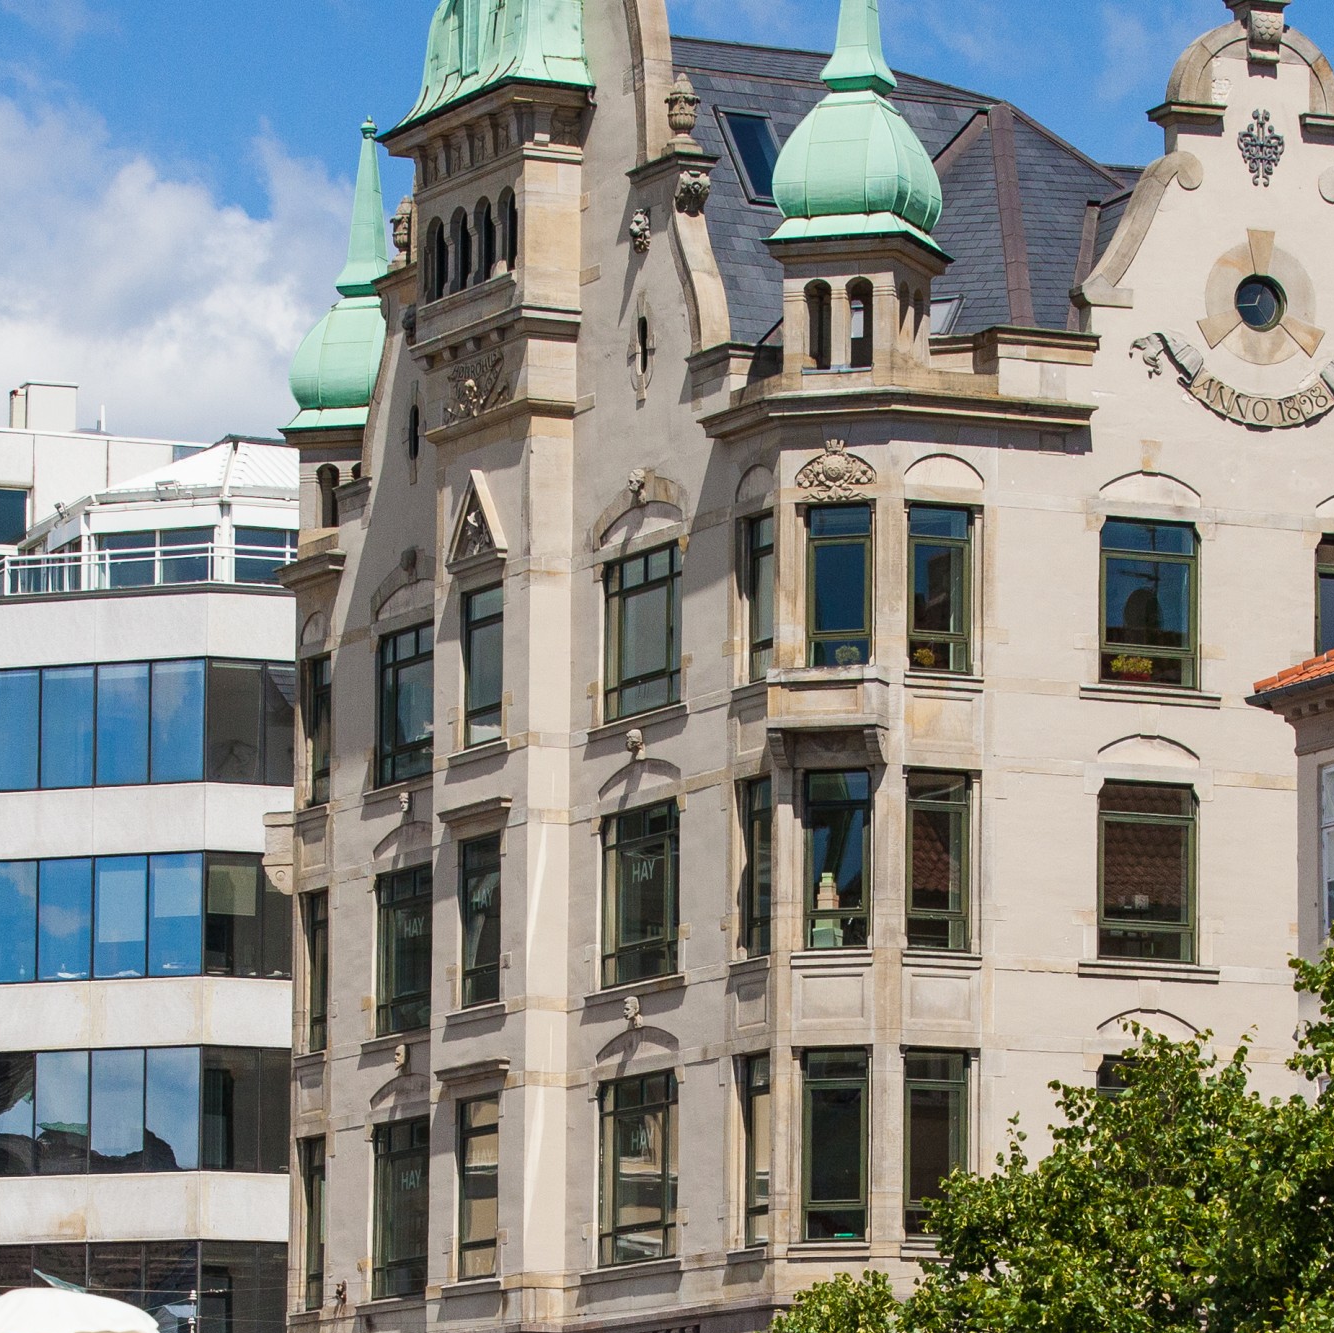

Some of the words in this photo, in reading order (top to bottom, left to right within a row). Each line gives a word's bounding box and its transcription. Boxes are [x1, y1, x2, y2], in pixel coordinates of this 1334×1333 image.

[1193, 380, 1271, 423] ANNO
[1277, 385, 1329, 424] 1898
[632, 861, 656, 884] HAY
[404, 916, 425, 938] HAY
[631, 1127, 655, 1152] HAY
[401, 1168, 422, 1192] HAY
